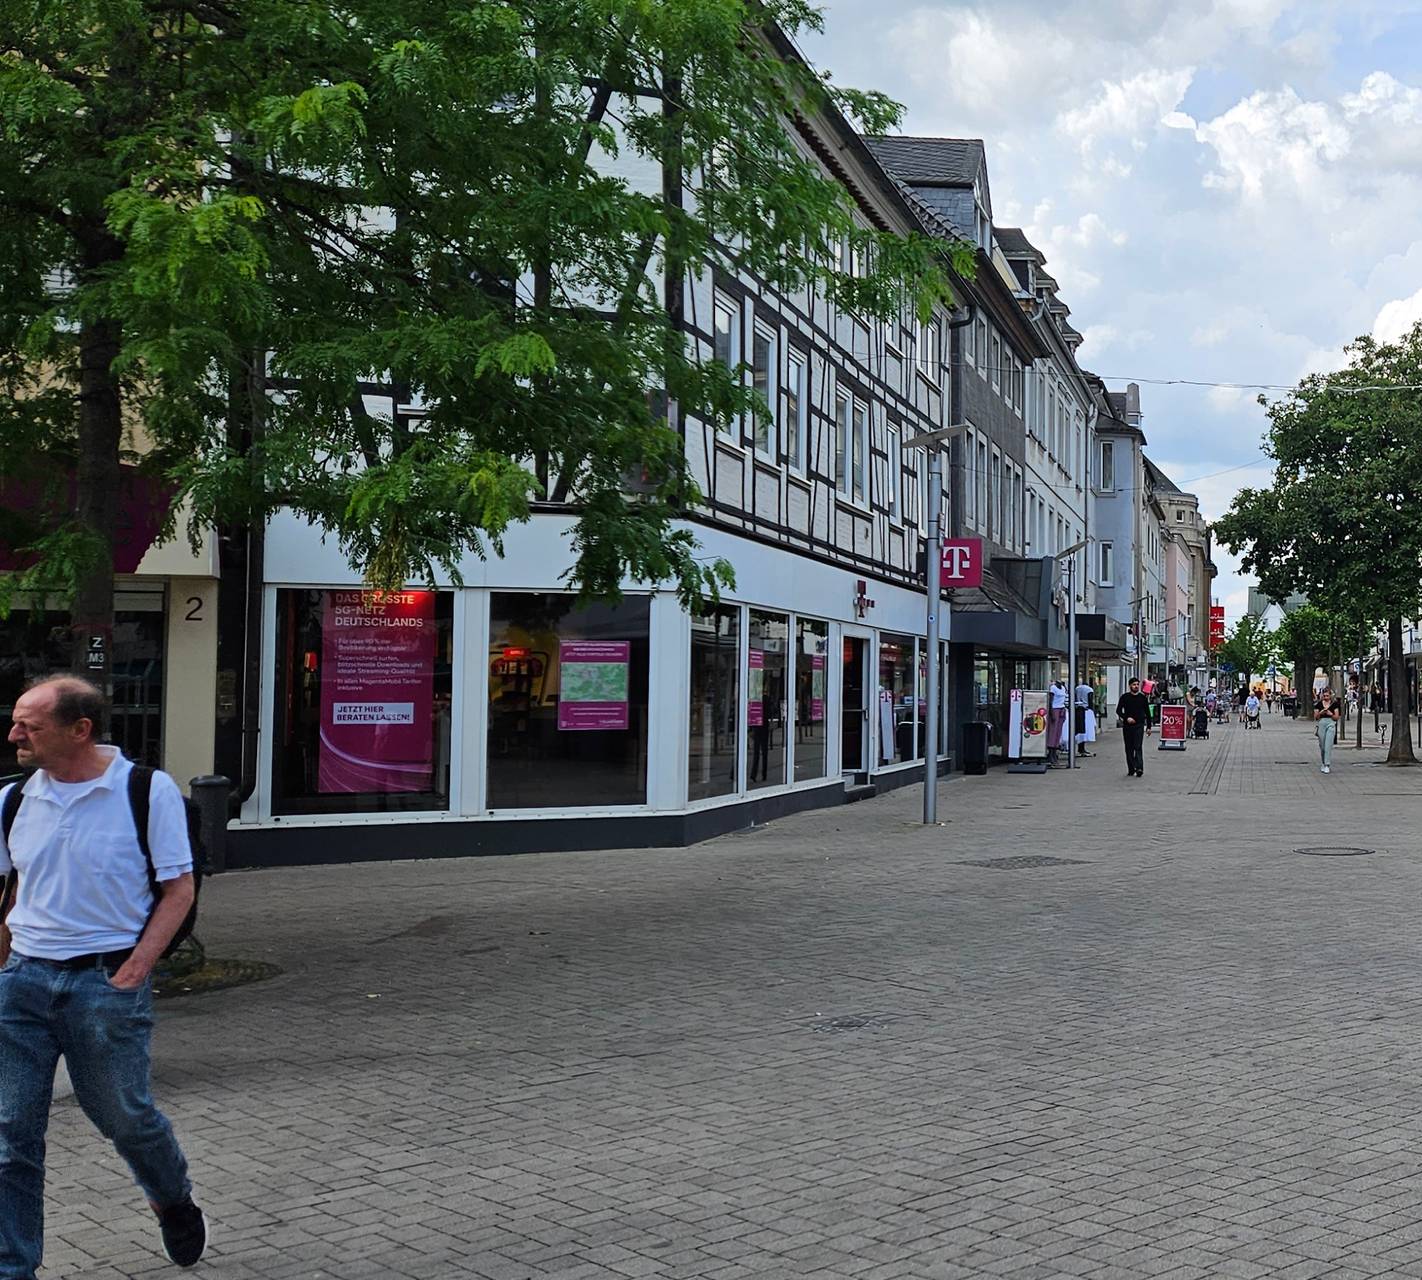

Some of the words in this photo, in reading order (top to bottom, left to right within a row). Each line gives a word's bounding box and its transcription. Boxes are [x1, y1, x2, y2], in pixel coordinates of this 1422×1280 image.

[943, 546, 970, 579] T
[335, 593, 359, 603] DAS
[185, 597, 203, 621] 2
[335, 606, 386, 615] 5G-NETZ
[335, 617, 424, 627] DEUTSCHLANDS
[92, 637, 103, 648] Z
[89, 653, 104, 663] M3
[338, 705, 363, 713] JETZT
[364, 705, 384, 713] HIER
[336, 713, 374, 721] BERATEN
